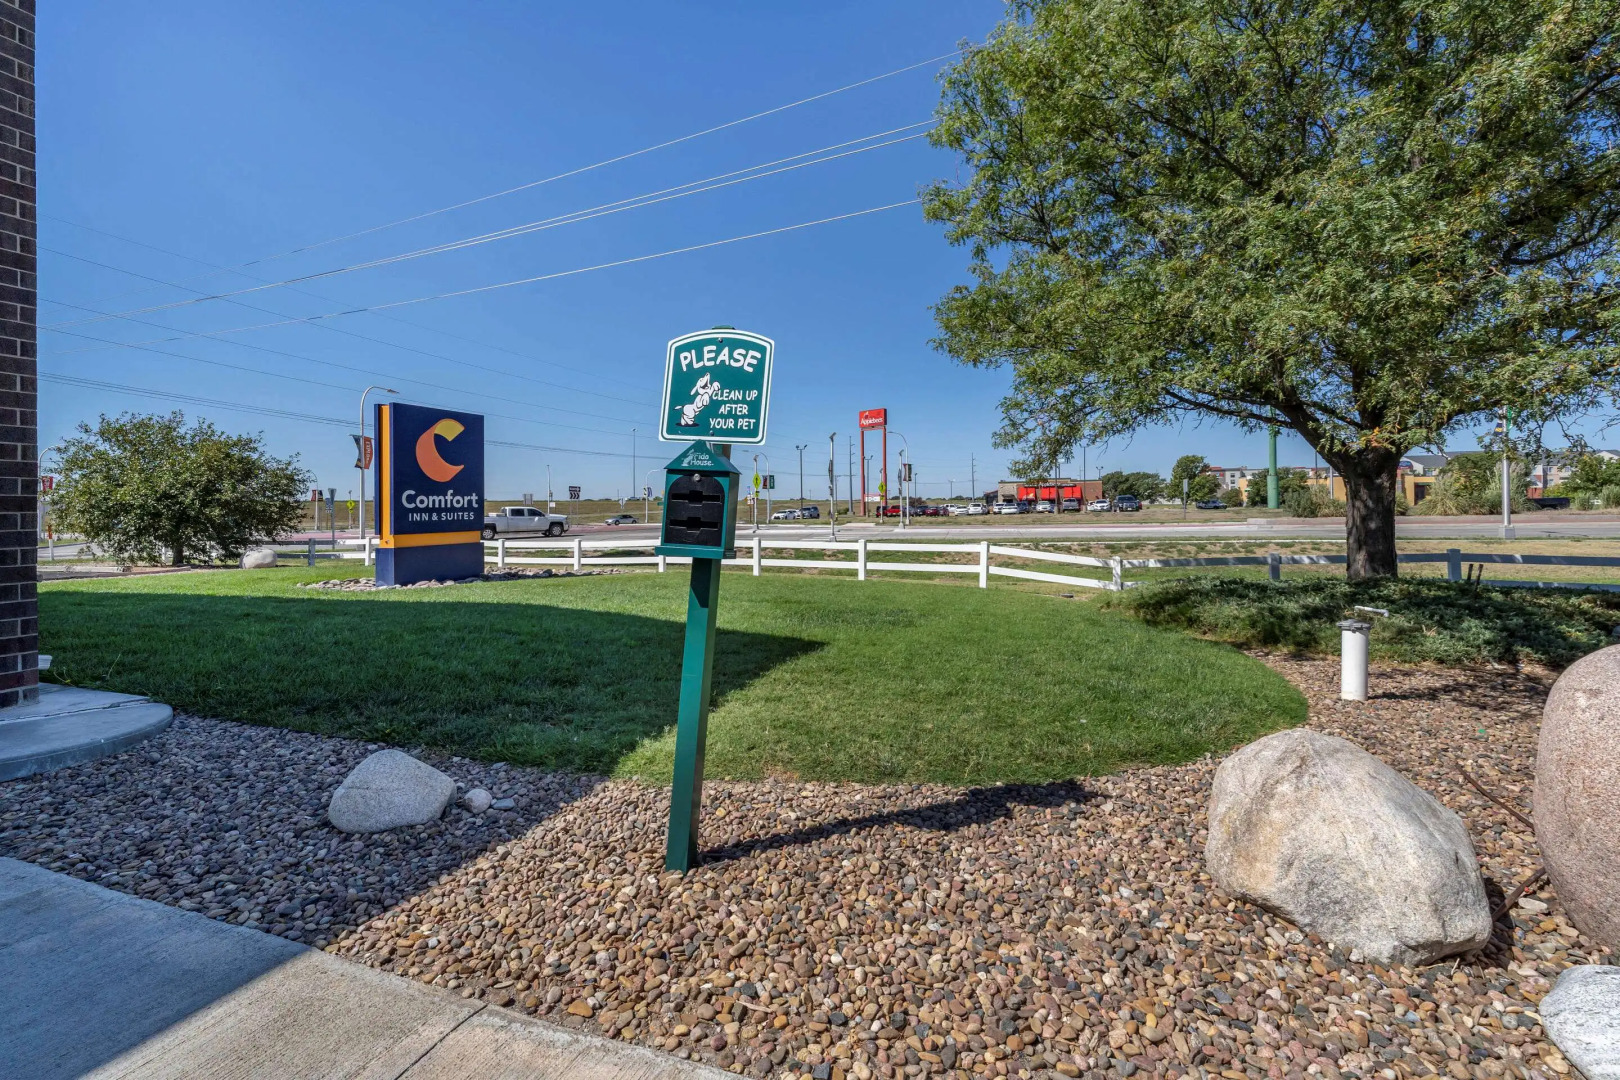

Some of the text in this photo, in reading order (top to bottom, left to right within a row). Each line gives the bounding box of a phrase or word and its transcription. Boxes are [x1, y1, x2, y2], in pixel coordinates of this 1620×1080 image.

[680, 345, 761, 372] PLEASE
[712, 389, 758, 400] CLEAN UP
[719, 404, 748, 414] AFTER
[709, 418, 756, 429] YOUR PET
[401, 489, 478, 508] Comfort
[409, 512, 475, 521] INN & SUITES
